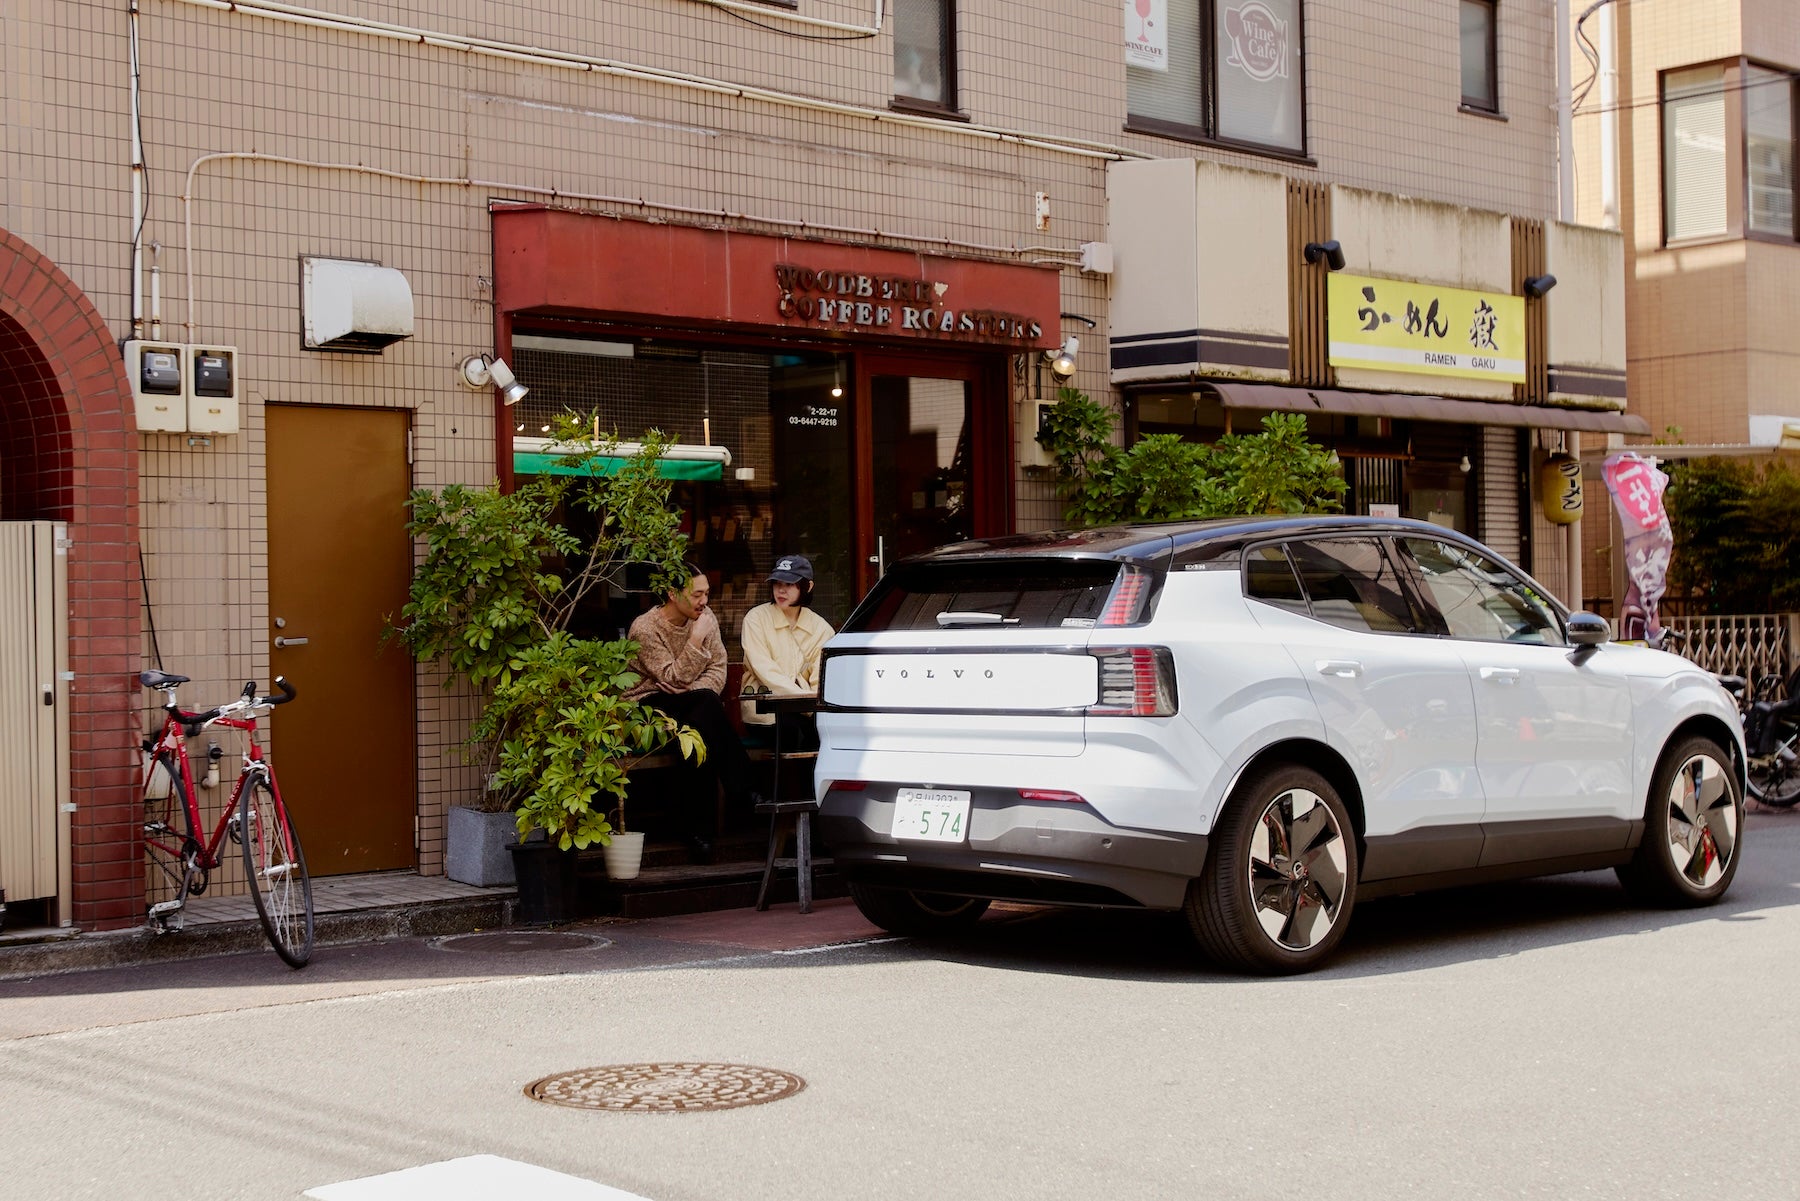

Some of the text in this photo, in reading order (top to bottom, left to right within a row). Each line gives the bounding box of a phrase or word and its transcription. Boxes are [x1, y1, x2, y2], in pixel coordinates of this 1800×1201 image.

[1242, 20, 1274, 41] Wine
[779, 294, 893, 328] COFFEE
[902, 306, 1043, 339] ROASTERS
[1358, 286, 1448, 338] らーめん
[1425, 353, 1496, 369] RAMEN GAKU
[876, 669, 993, 679] VOLVO
